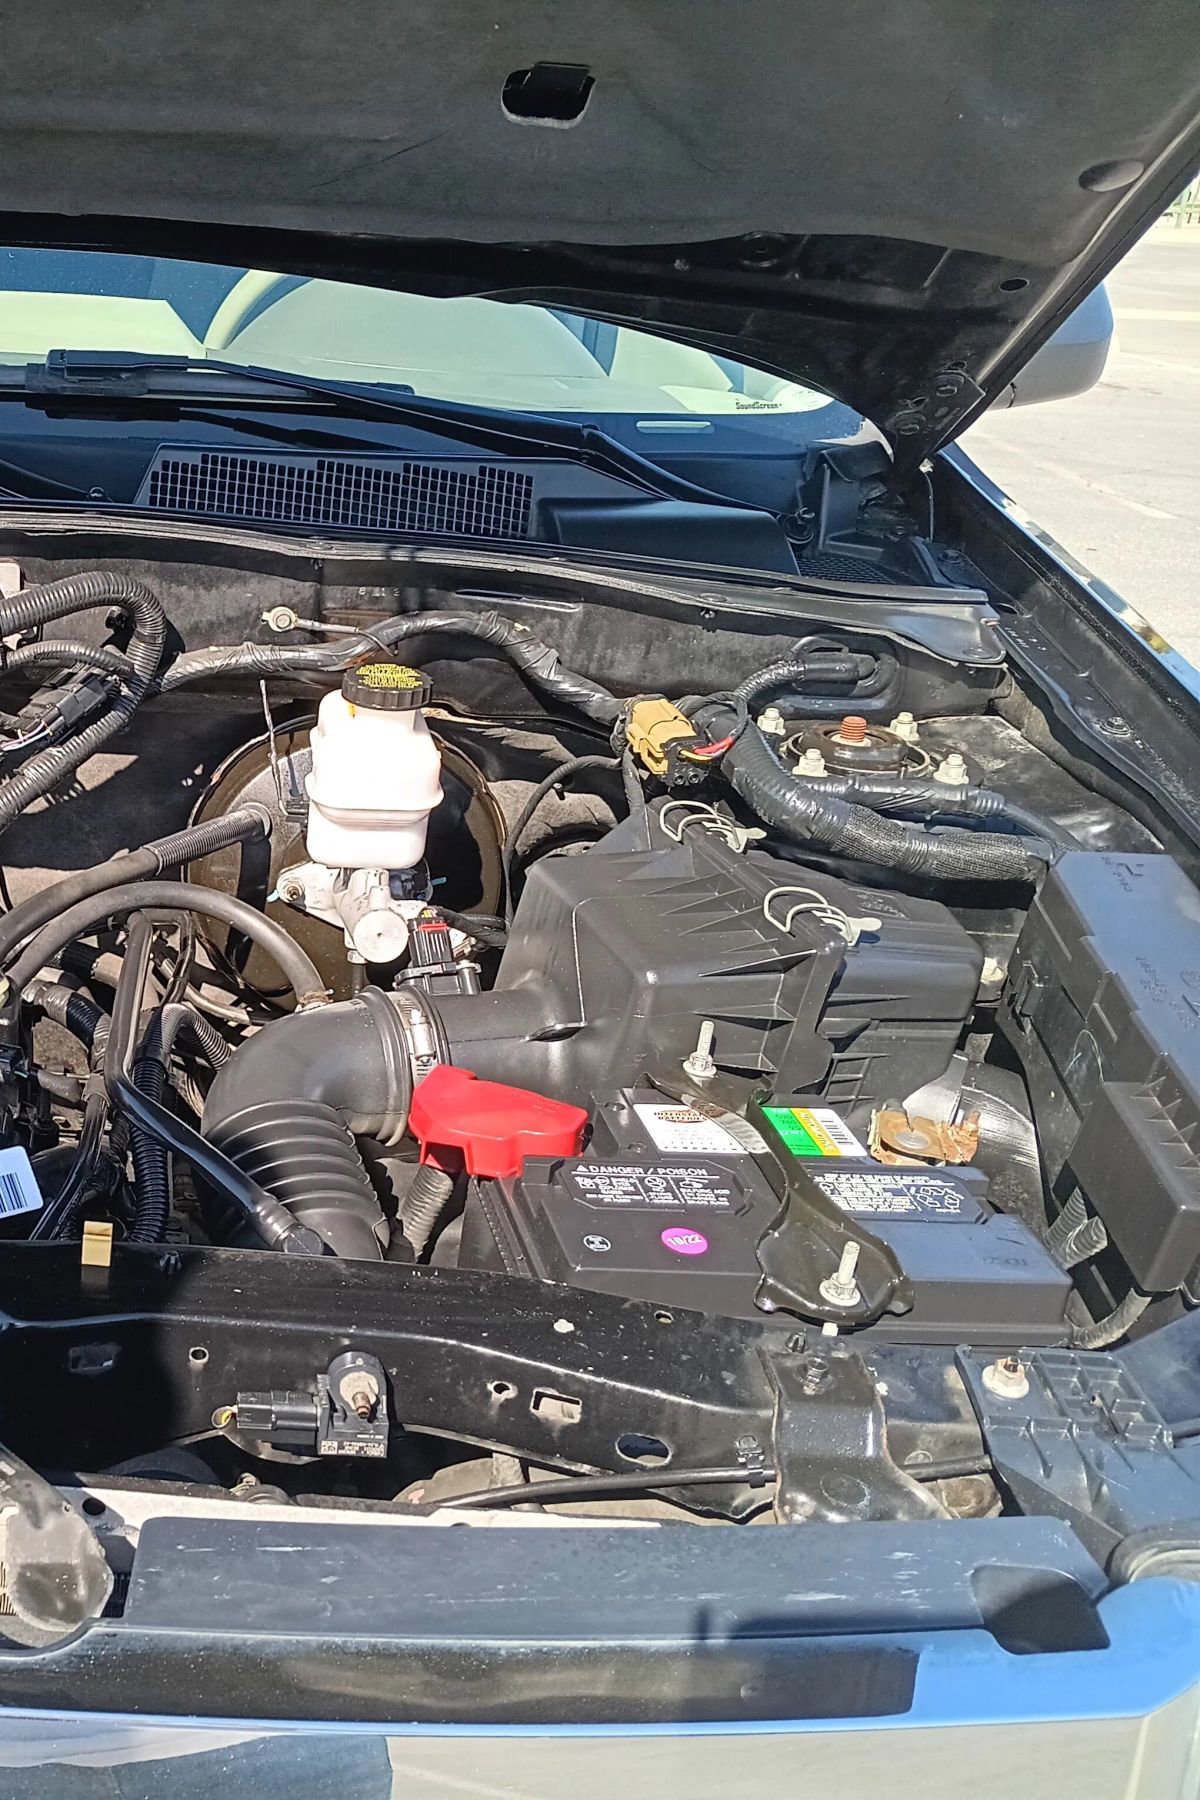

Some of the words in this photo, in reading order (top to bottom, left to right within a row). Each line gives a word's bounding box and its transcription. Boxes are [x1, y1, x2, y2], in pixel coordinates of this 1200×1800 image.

[735, 401, 779, 410] SoundScreen
[588, 1165, 644, 1175] DANGER
[657, 1168, 708, 1176] POISON
[666, 1234, 704, 1247] 10/22
